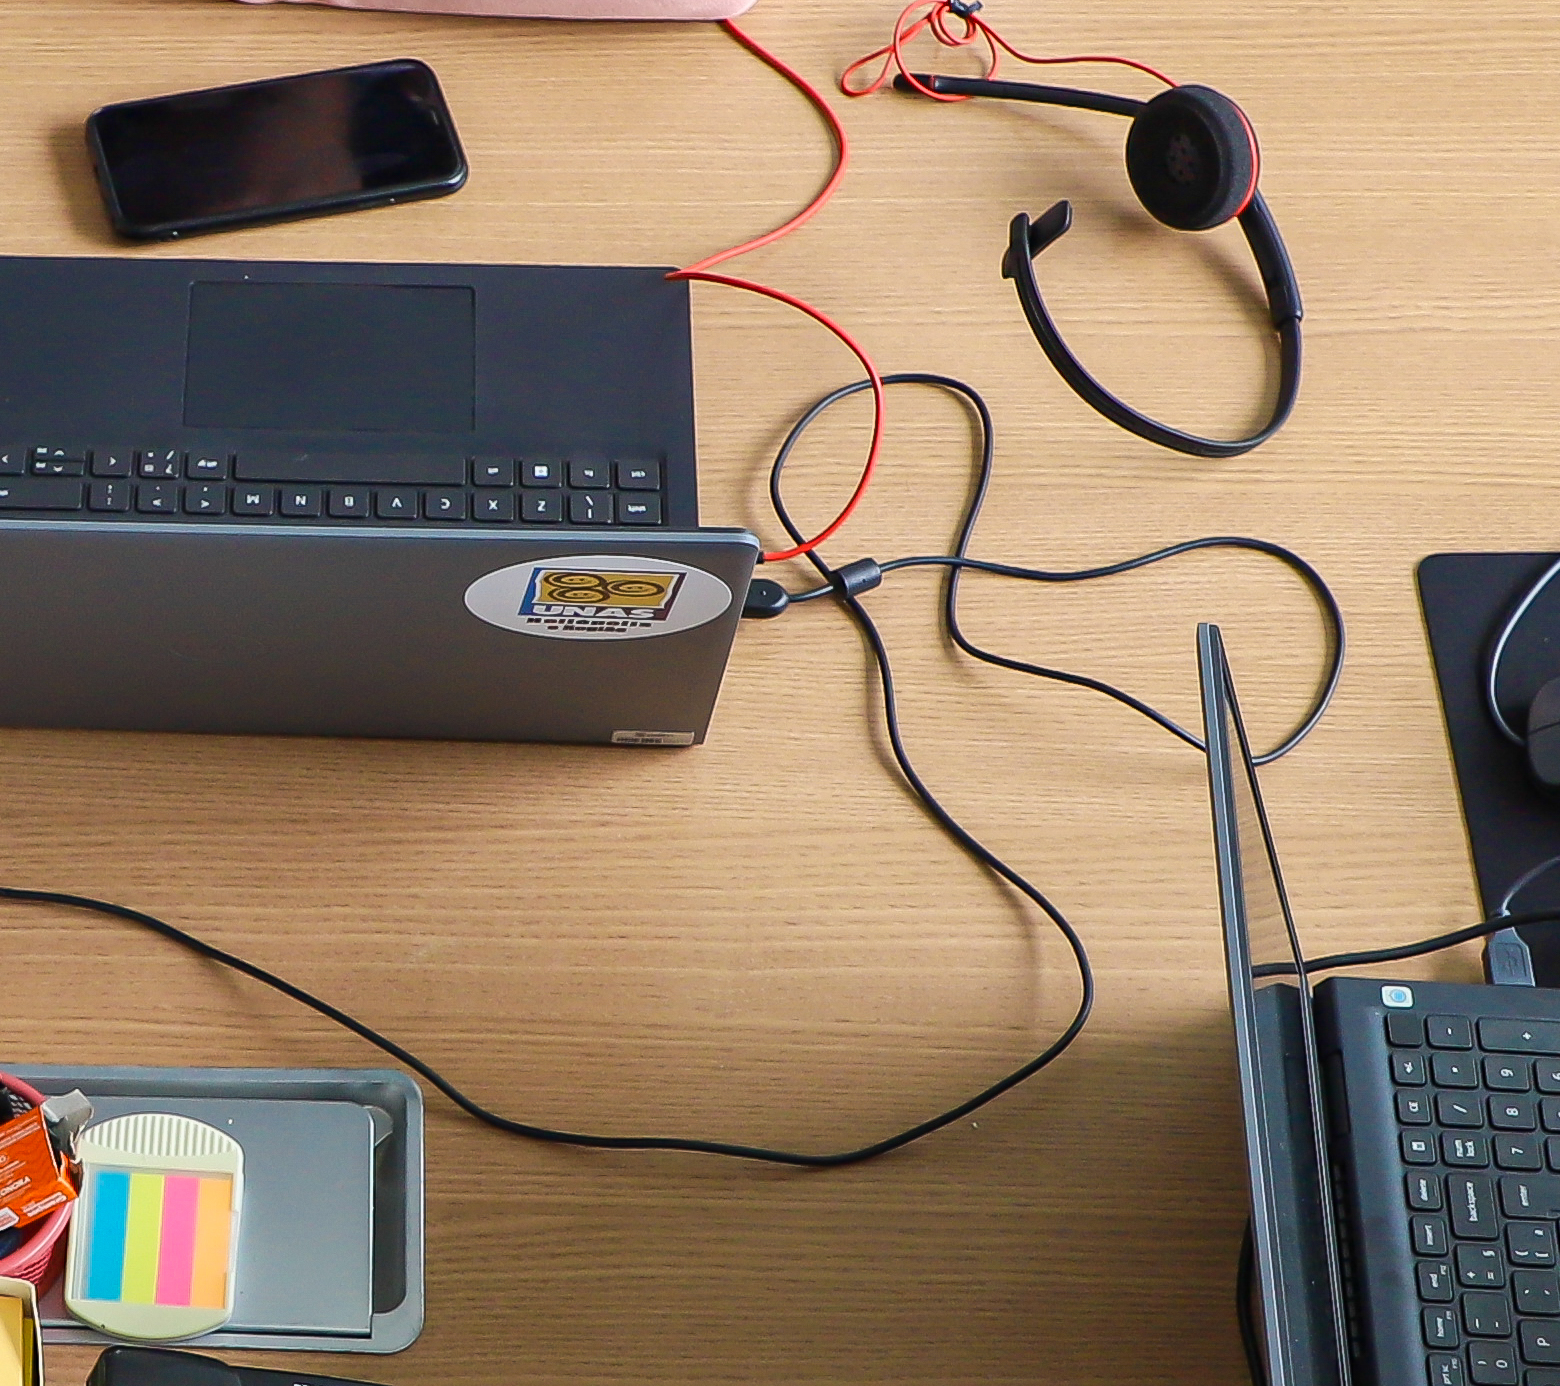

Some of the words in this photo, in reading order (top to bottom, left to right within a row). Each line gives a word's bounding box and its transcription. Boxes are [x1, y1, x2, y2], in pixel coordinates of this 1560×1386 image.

[533, 605, 654, 619] UNAS
[1500, 1068, 1514, 1077] 9
[1505, 1107, 1519, 1116] 8
[1511, 1147, 1524, 1155] 7
[1536, 1337, 1551, 1347] P
